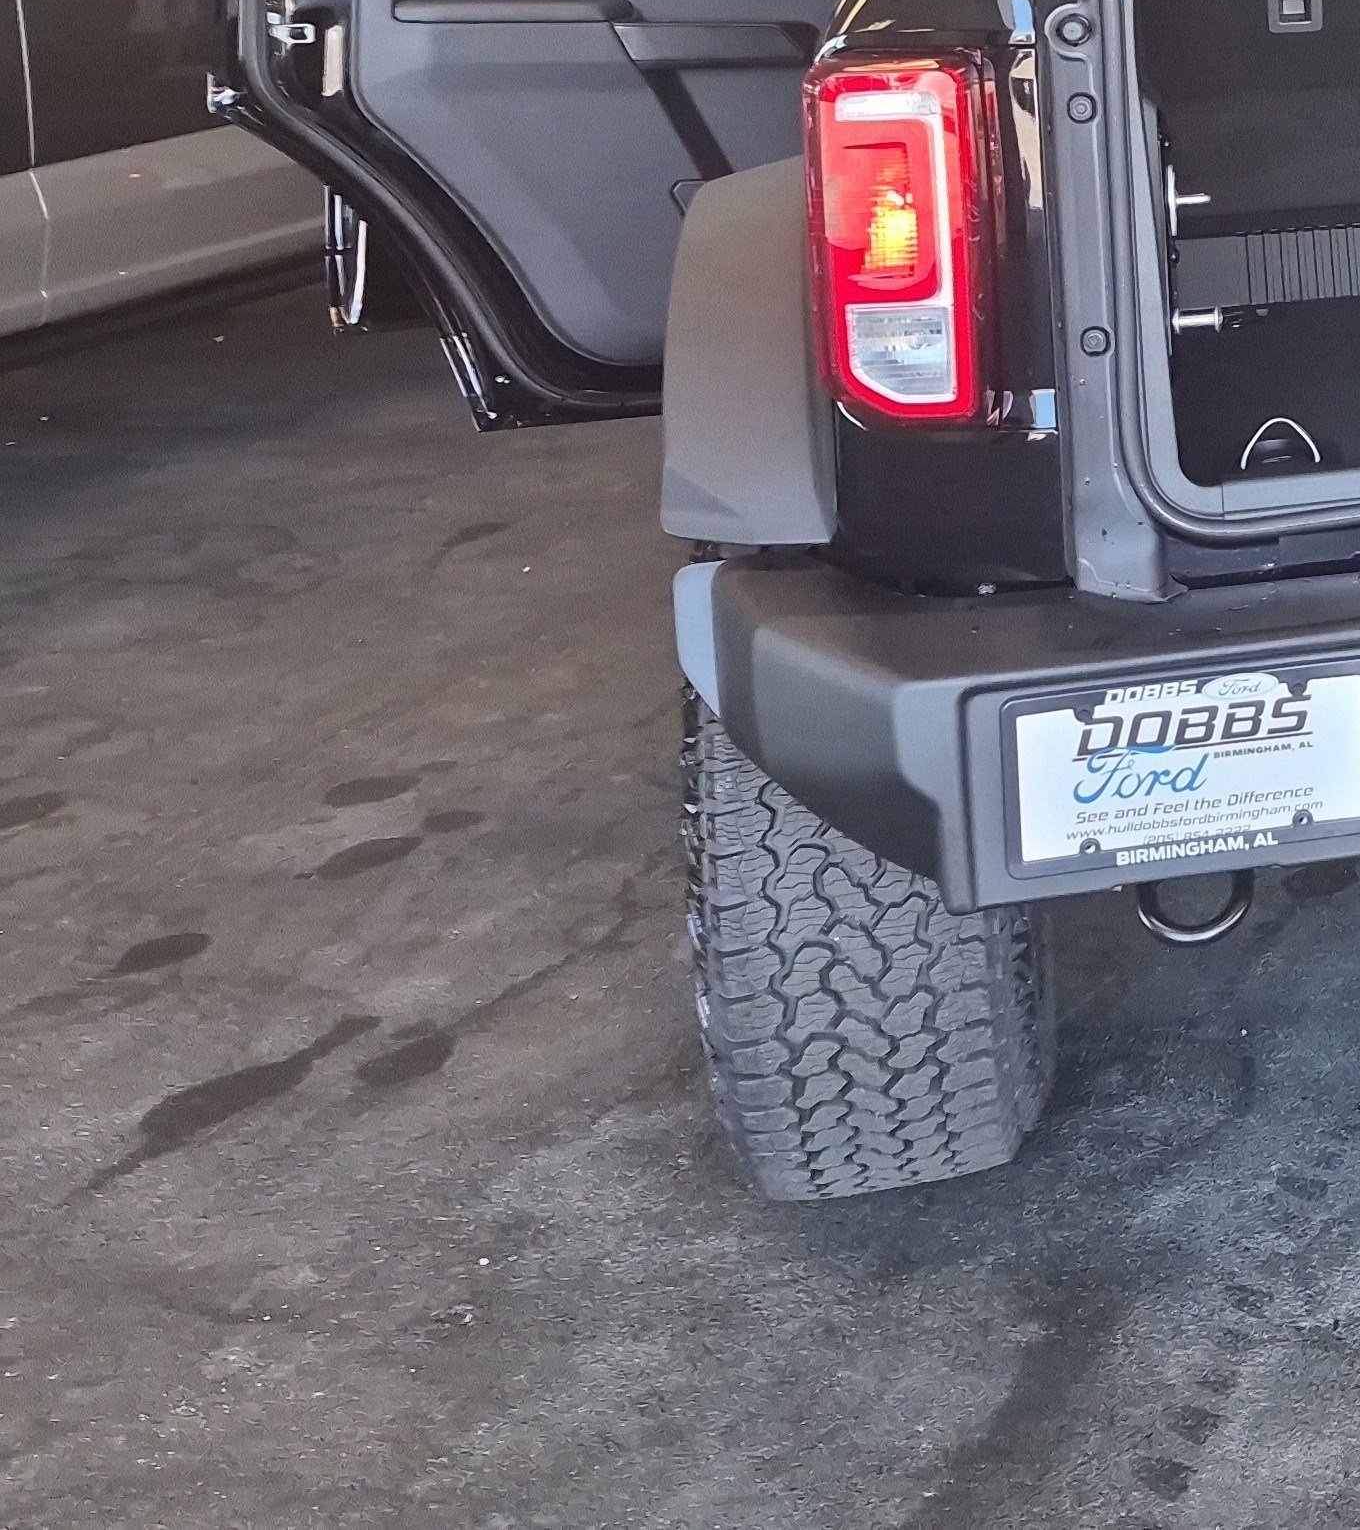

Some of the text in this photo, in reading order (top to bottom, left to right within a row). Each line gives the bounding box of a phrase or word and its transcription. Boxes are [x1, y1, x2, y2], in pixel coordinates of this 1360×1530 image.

[1104, 678, 1261, 705] DOBBS Ford
[1077, 693, 1312, 757] DOBBS
[1213, 740, 1313, 759] BIRMINGHAM, AL
[1073, 744, 1210, 804] Ford
[1076, 786, 1314, 825] See and Feel the Difference
[1116, 831, 1279, 866] BIRMINGHAM, AL
